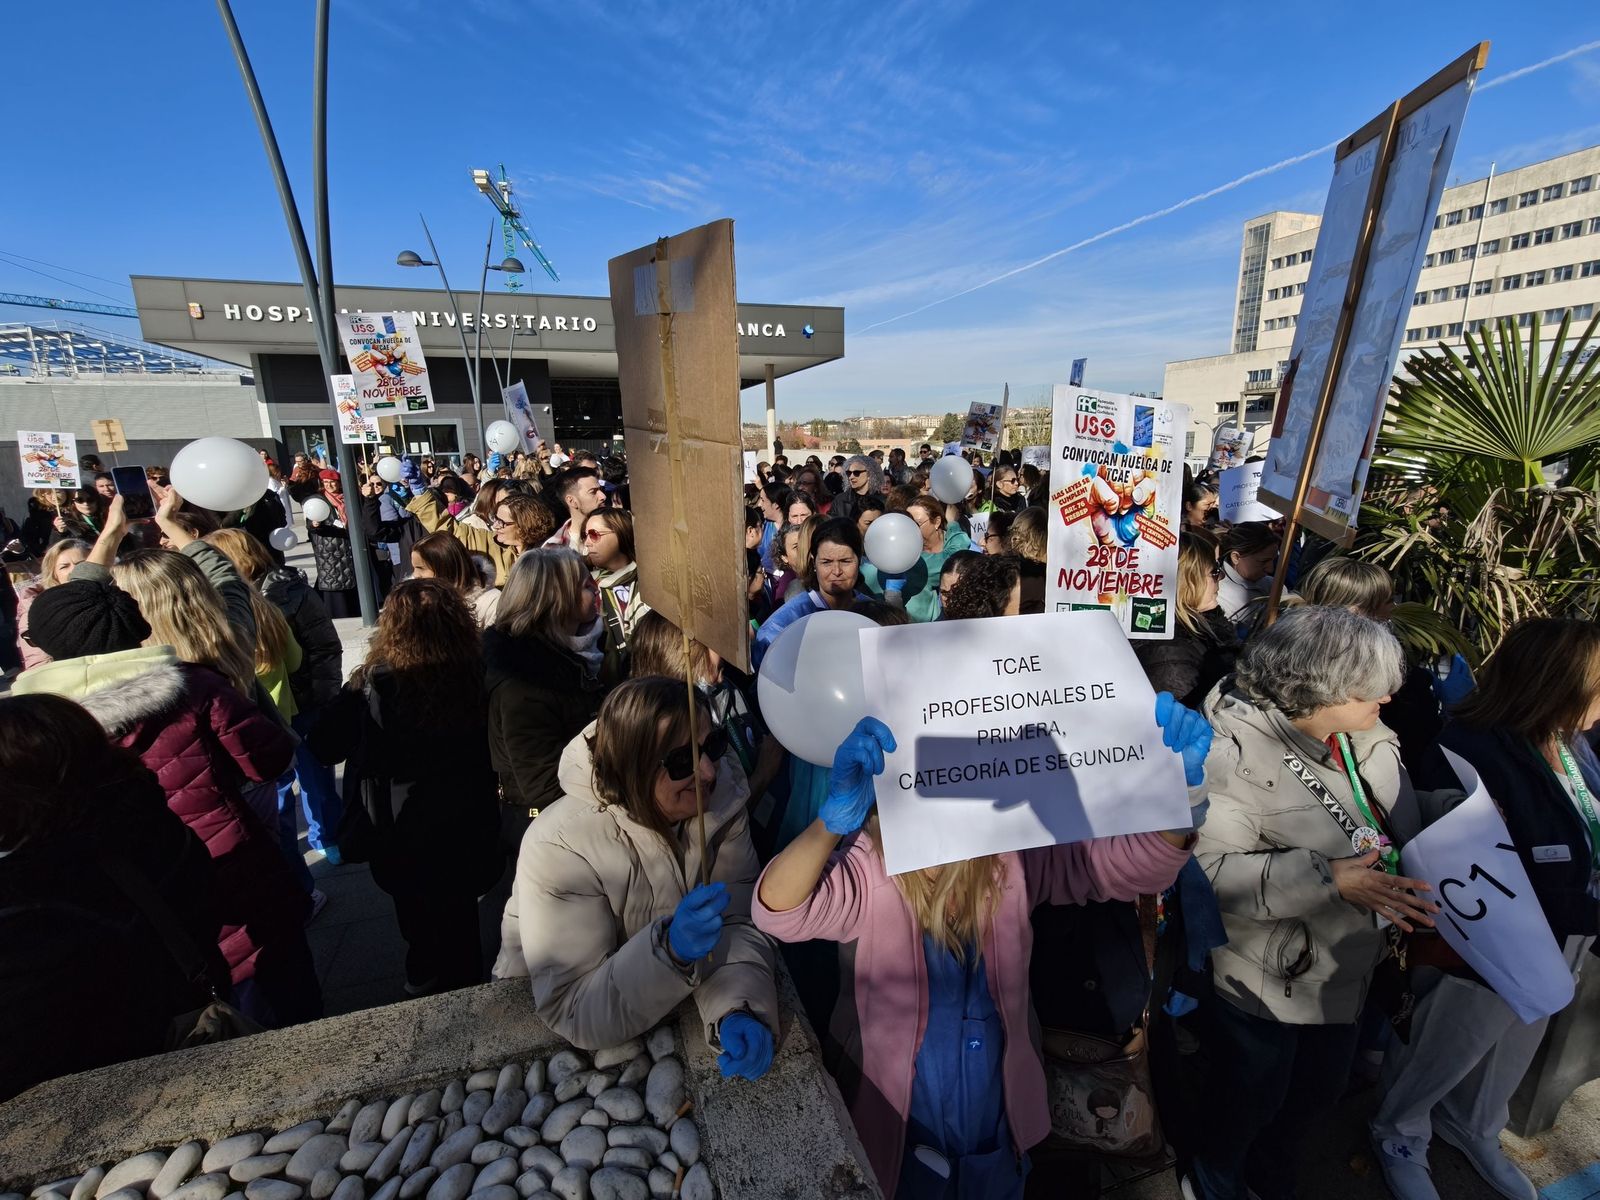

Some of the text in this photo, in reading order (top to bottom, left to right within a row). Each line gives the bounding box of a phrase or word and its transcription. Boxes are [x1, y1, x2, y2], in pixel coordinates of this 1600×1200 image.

[223, 303, 786, 337] HOSPI NIVERSITARIO ANCA
[351, 324, 375, 333] USO
[349, 338, 381, 346] CONVOCAN
[376, 376, 406, 388] 28 DE
[363, 385, 422, 399] NOVIEMBRE
[1075, 413, 1116, 438] USO
[1062, 445, 1118, 468] CONVOCAN
[1120, 454, 1158, 472] HUELGA
[1161, 459, 1173, 473] DE
[1106, 467, 1131, 484] TCAE
[1252, 471, 1262, 479] TC
[1065, 482, 1082, 494] LEYES
[1082, 477, 1090, 485] SE
[1058, 487, 1088, 506] CUMPLEN!
[1146, 526, 1165, 541] CENTRO
[1085, 545, 1140, 568] 28 DE
[1057, 567, 1164, 598] NOVIEMBRE
[992, 655, 1042, 675] TCAE
[922, 682, 1116, 724] ¡PROFESIONALES DE
[977, 720, 1067, 746] PRIMERA,
[899, 744, 1145, 790] CATEGORÍA DE SEGUNDA!
